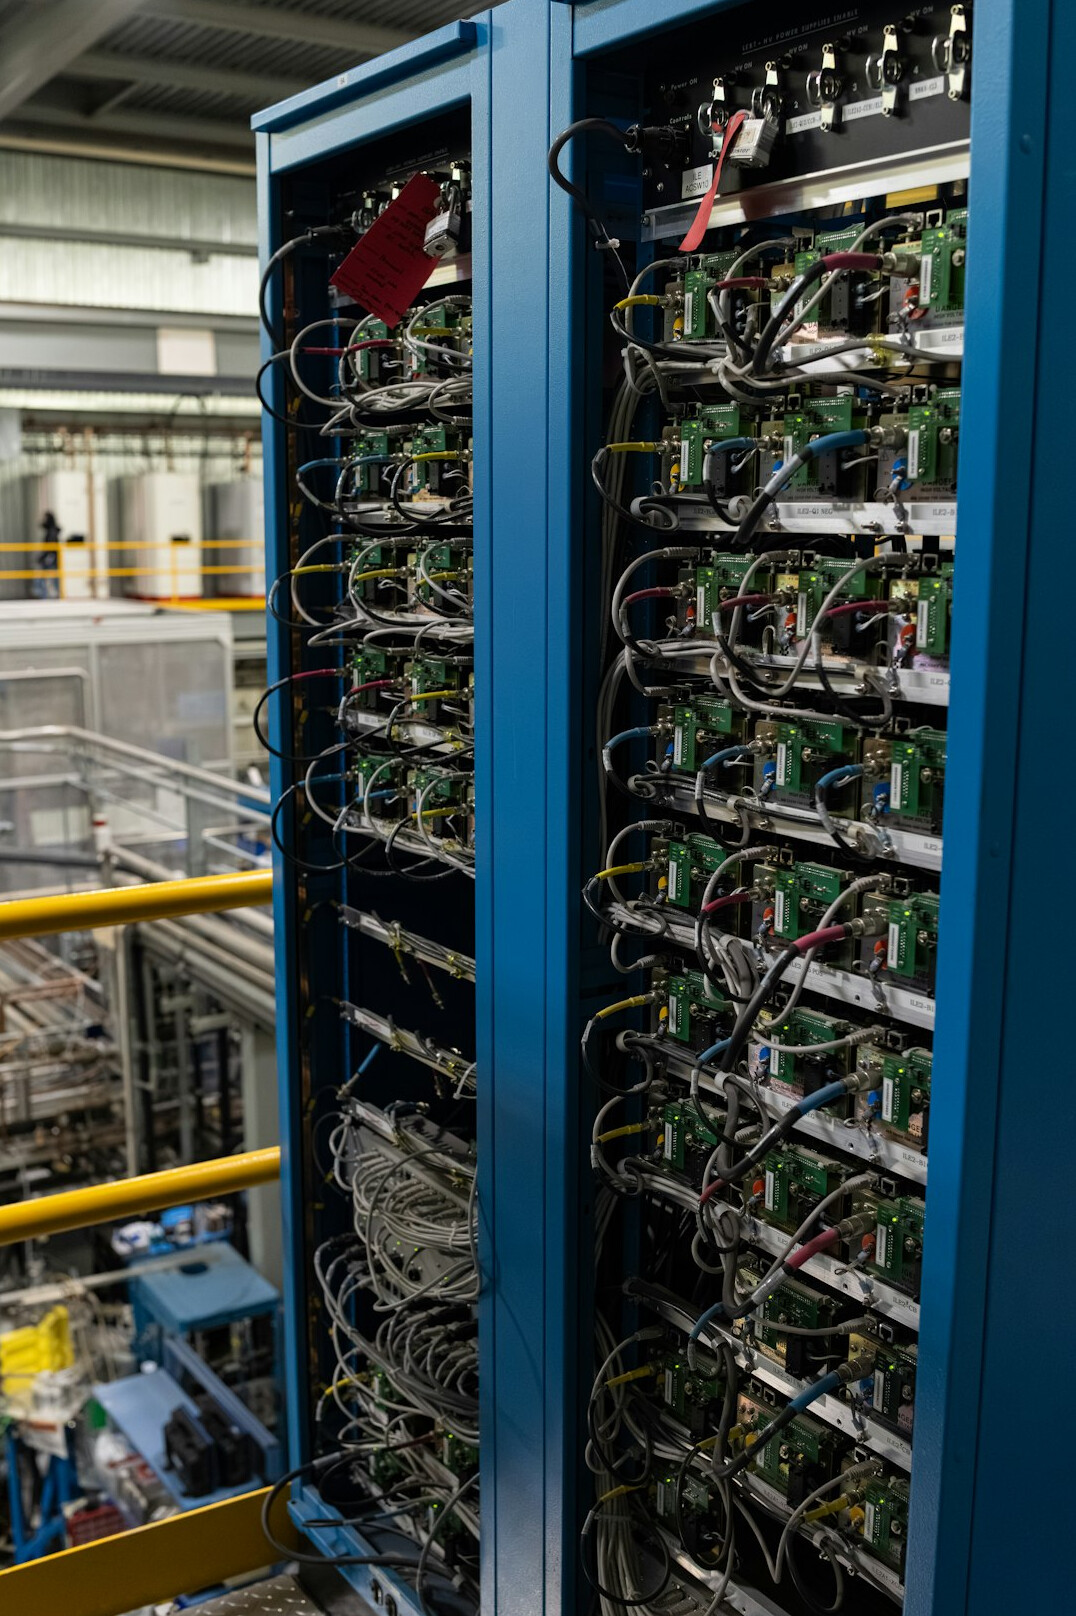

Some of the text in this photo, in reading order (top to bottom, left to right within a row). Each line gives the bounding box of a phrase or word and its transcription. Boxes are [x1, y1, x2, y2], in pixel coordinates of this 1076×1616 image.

[922, 6, 934, 15] ON
[776, 28, 798, 40] POWER
[801, 17, 831, 32] SUPPLIES
[833, 9, 858, 22] ENABLE
[857, 25, 868, 34] ON
[798, 43, 808, 51] ON
[913, 66, 918, 74] 4
[671, 81, 687, 90] Power
[852, 83, 857, 91] 3
[794, 101, 799, 109] 2
[669, 114, 693, 124] Controls
